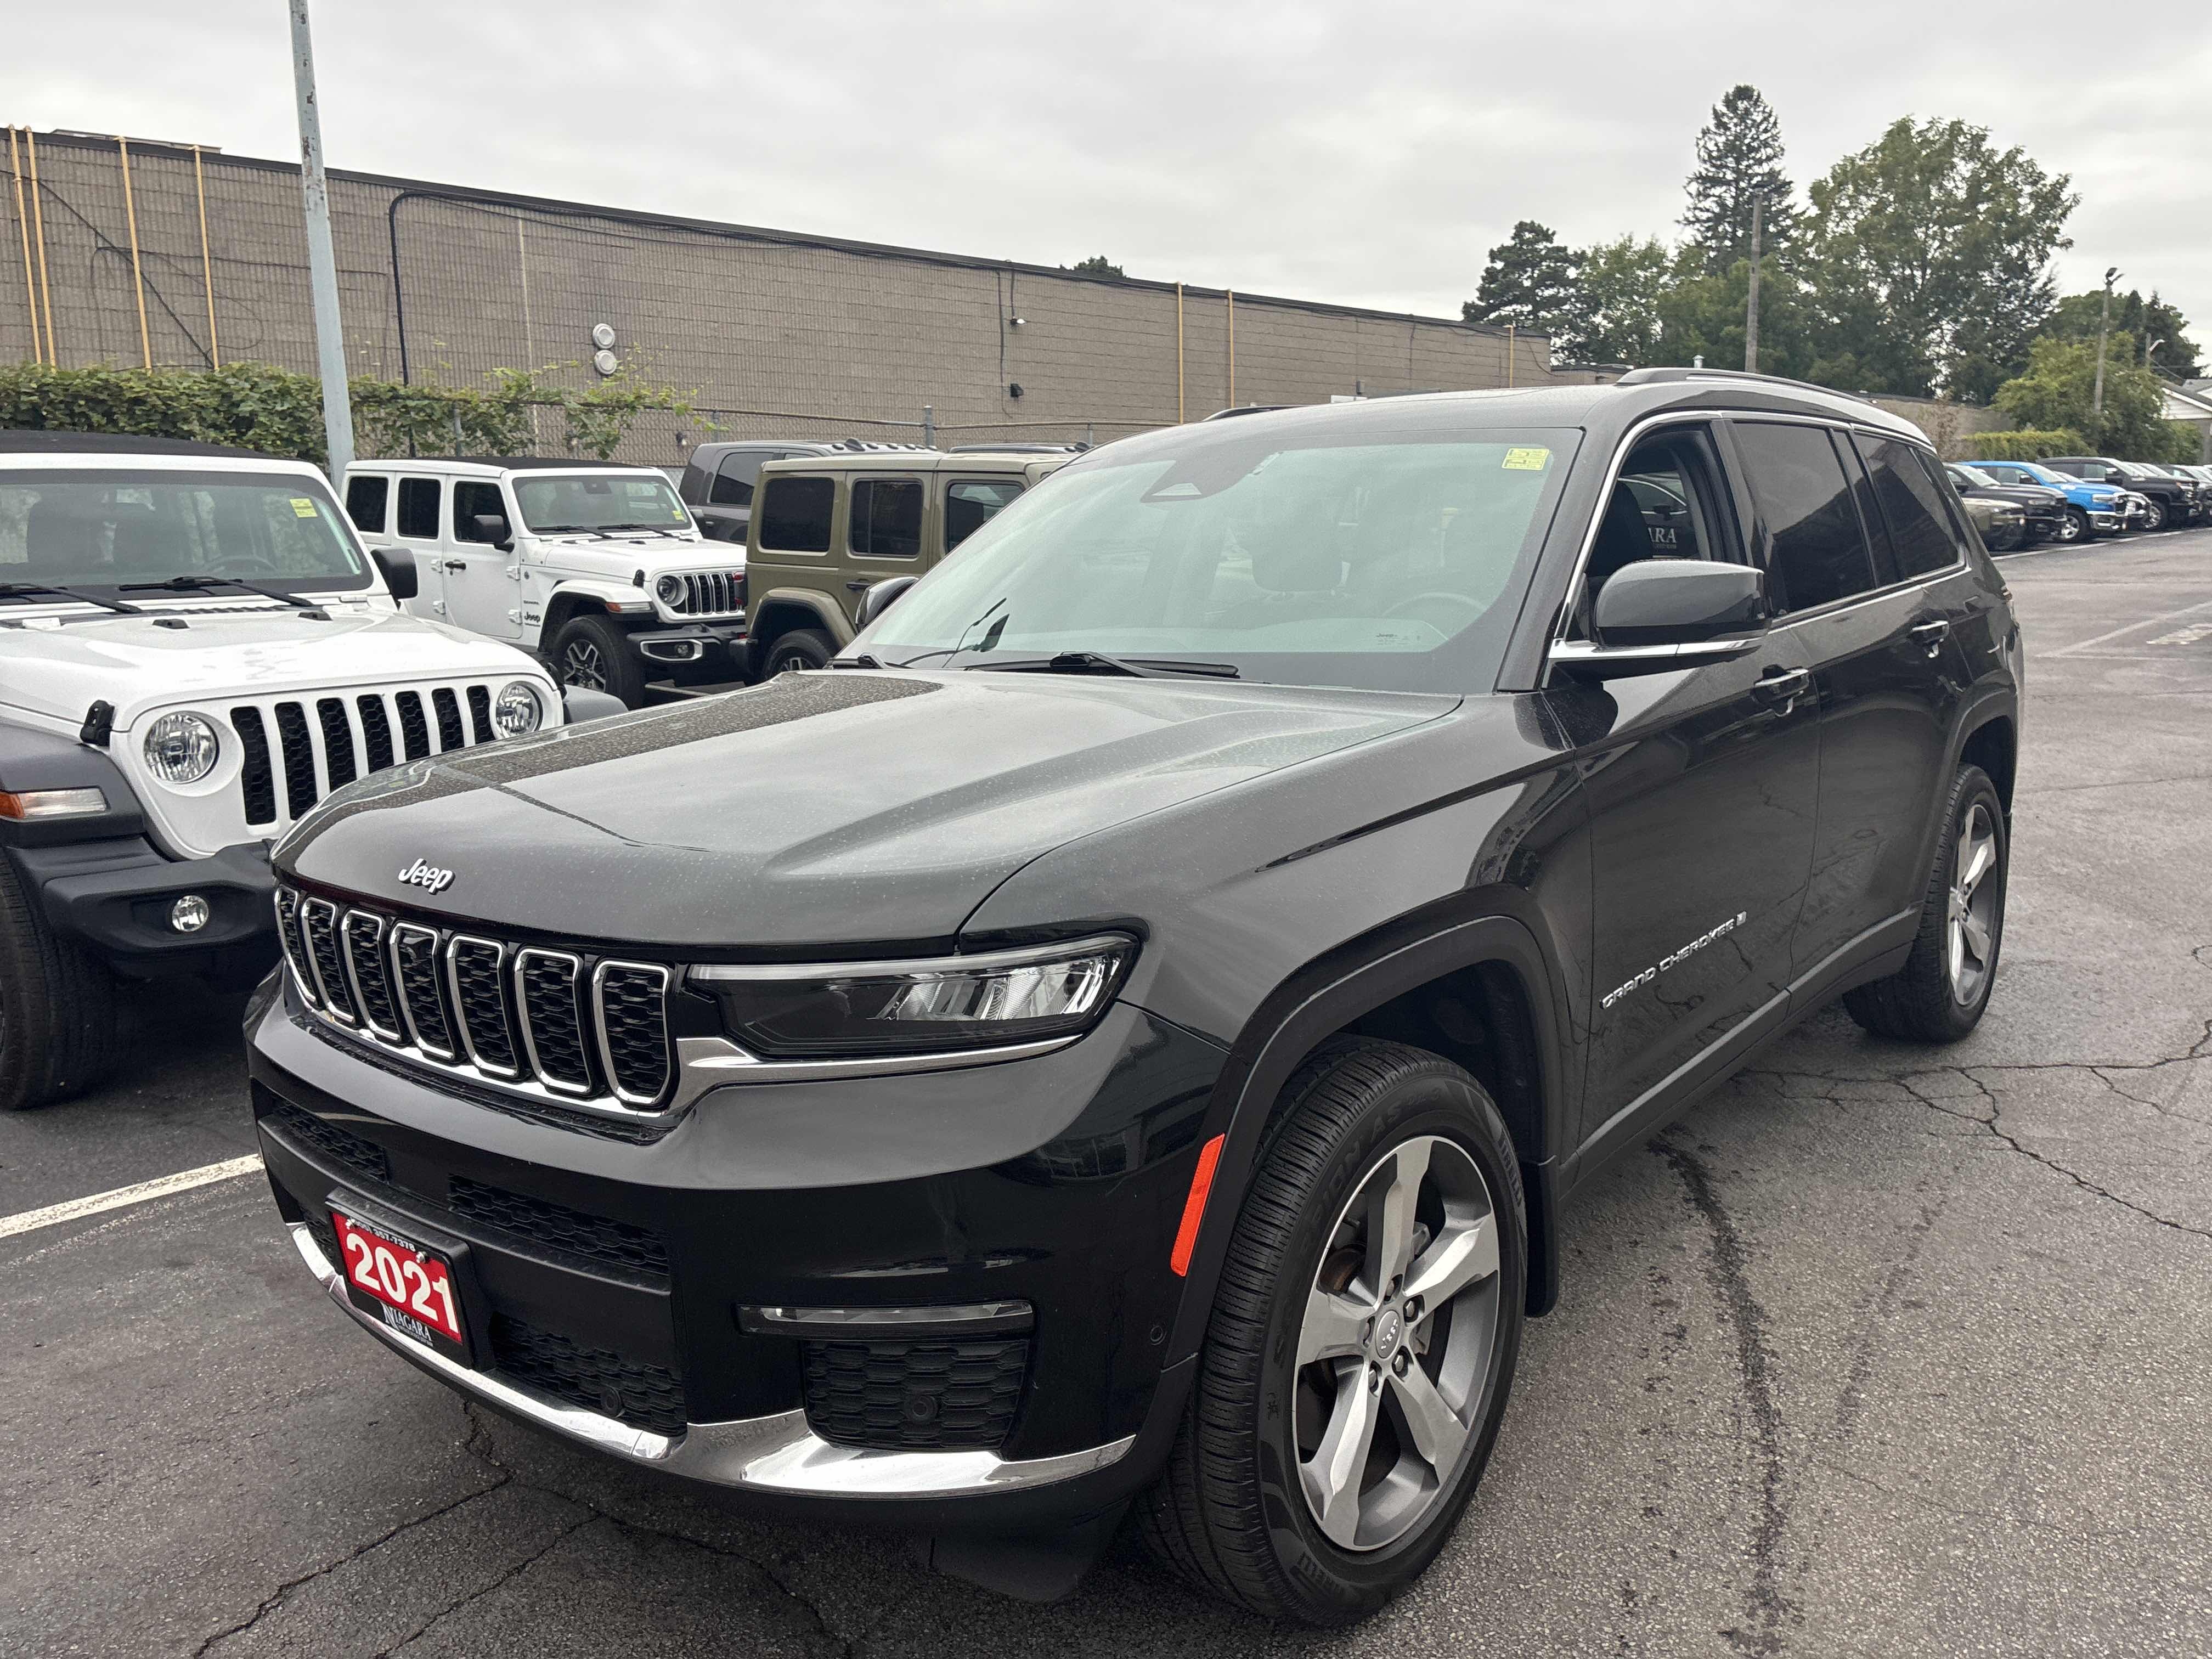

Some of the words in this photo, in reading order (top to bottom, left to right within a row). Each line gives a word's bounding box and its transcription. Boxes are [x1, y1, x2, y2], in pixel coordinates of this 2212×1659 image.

[398, 857, 455, 895] Jeep
[1601, 967, 1656, 1009] GRAND
[1658, 918, 1735, 972] CHEROKEE
[346, 1232, 459, 1334] 2021
[380, 1301, 432, 1342] NIAGARA
